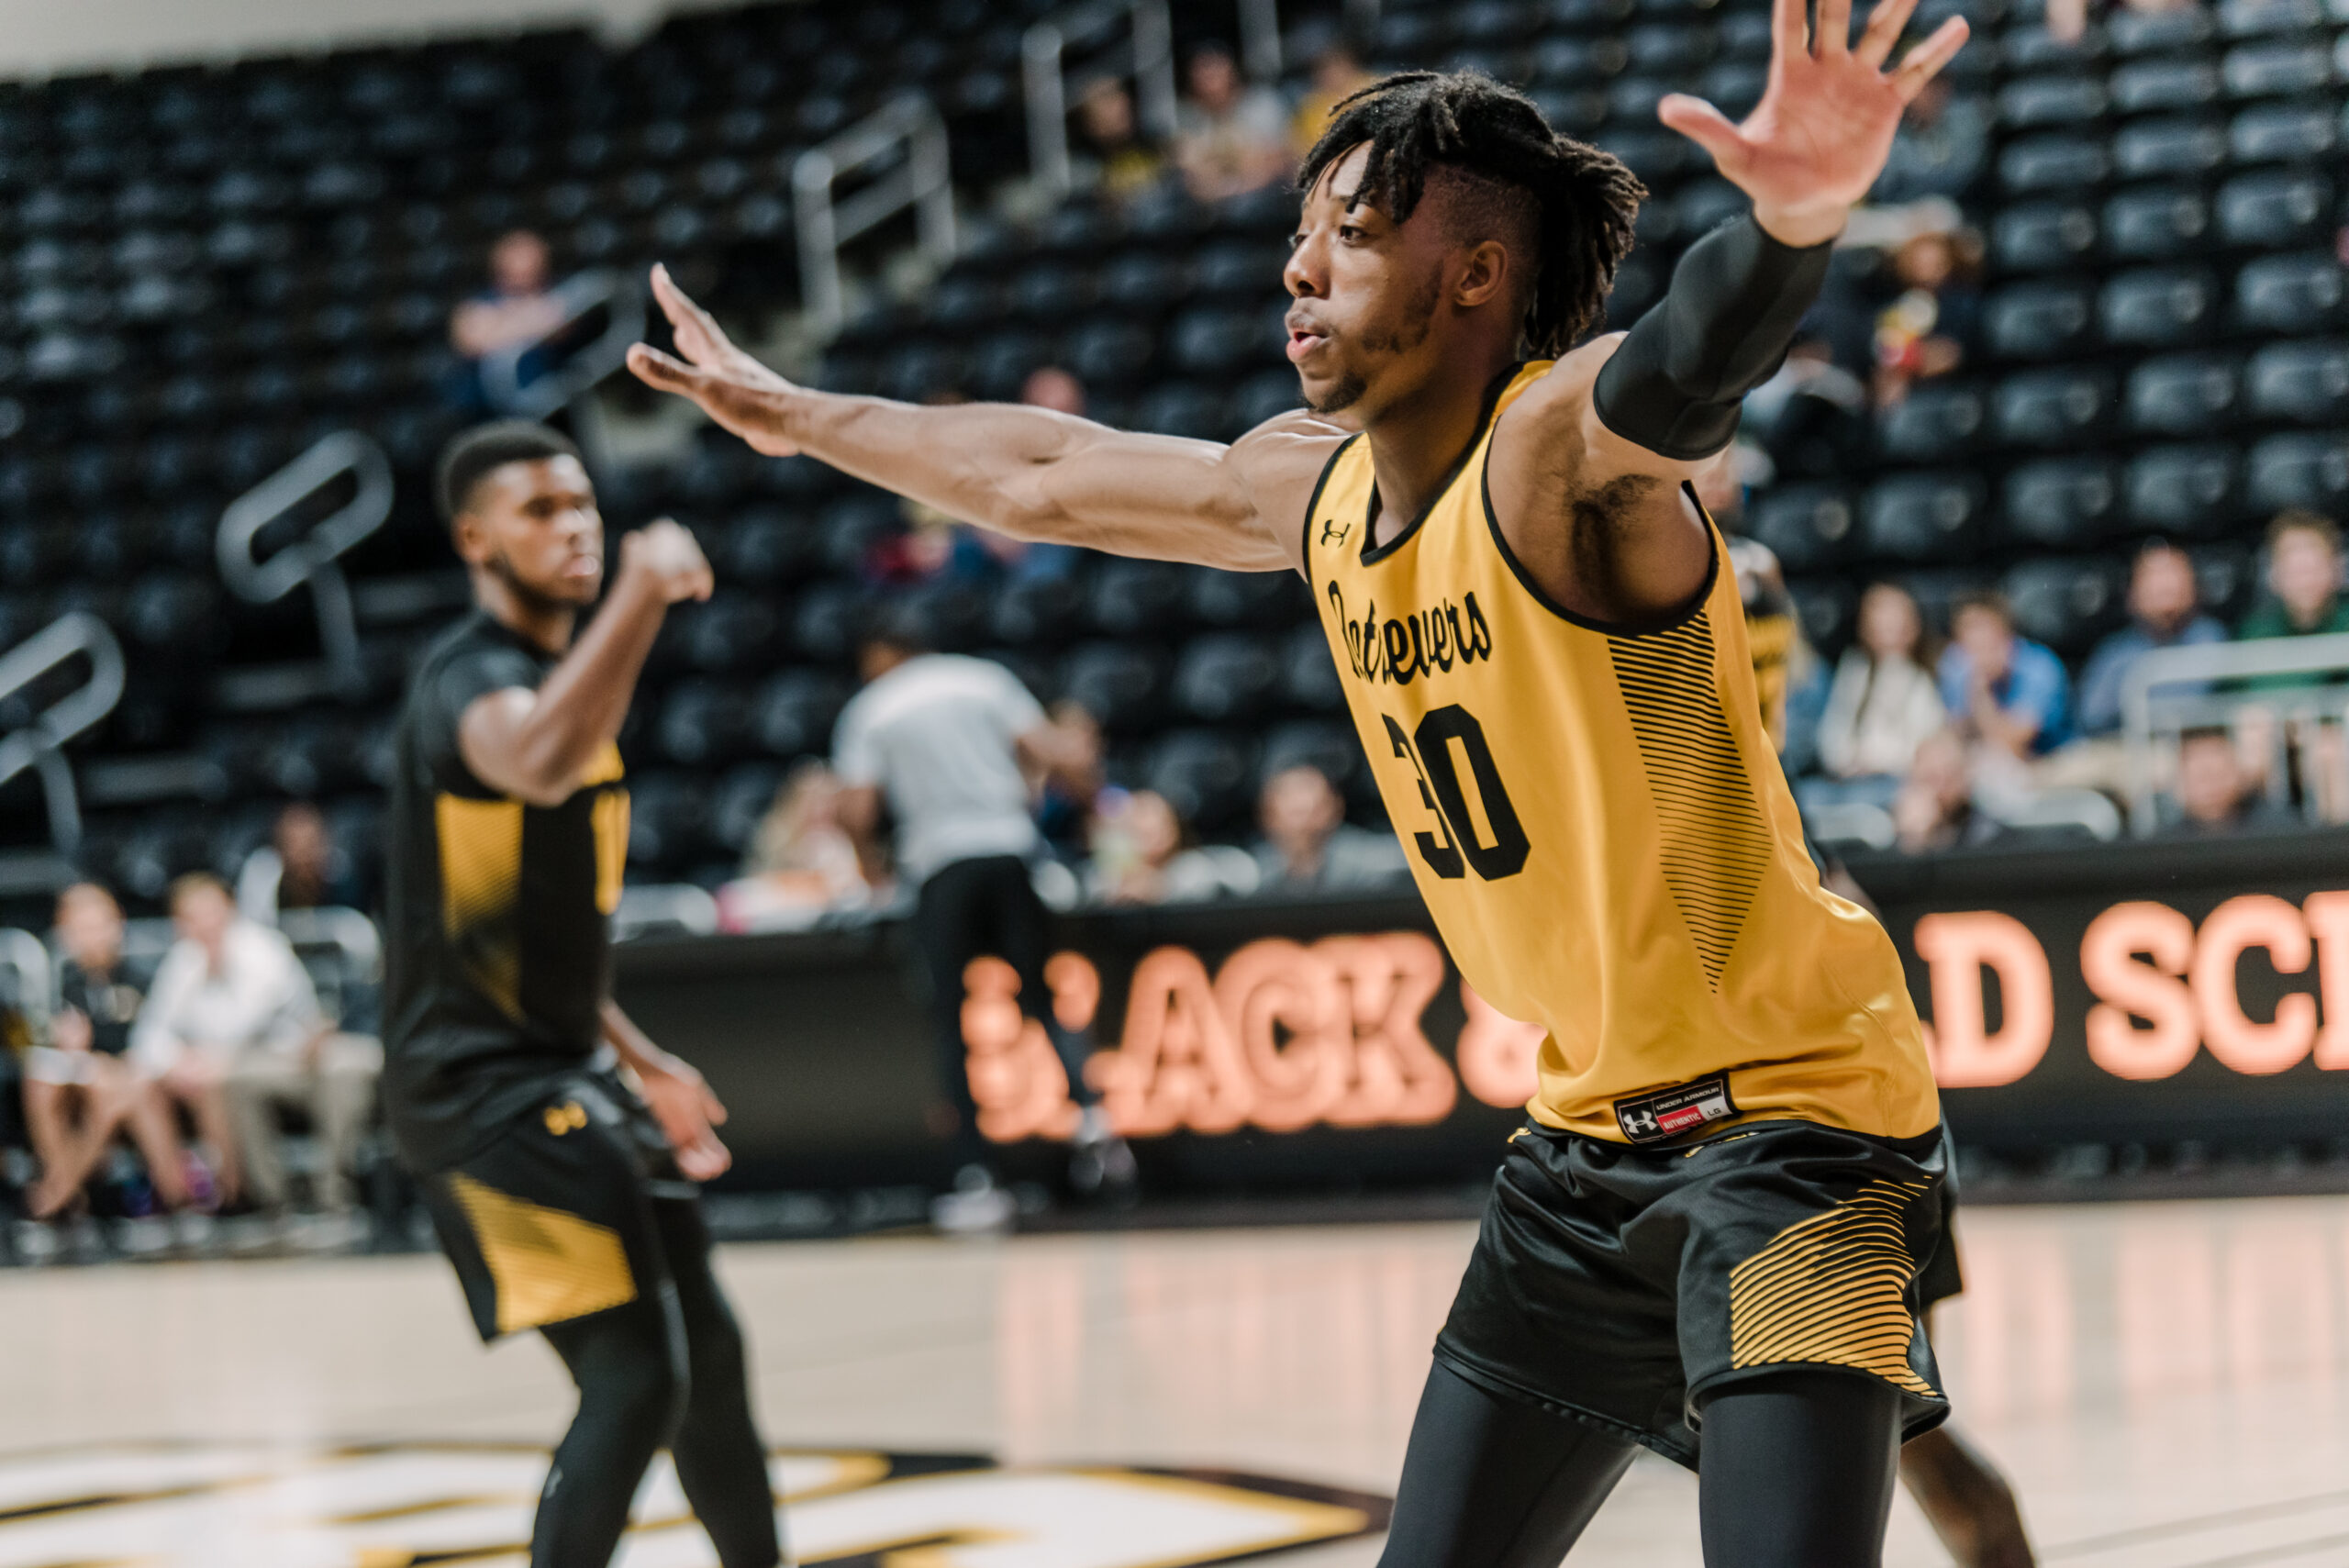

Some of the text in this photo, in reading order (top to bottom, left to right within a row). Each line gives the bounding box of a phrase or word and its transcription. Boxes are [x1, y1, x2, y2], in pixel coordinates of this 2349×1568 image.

[1381, 703, 1531, 882] 30
[1656, 1087, 1719, 1110] UNDER ARMOUR
[1664, 1113, 1701, 1129] AUTHENTIC
[1708, 1108, 1721, 1117] LG
